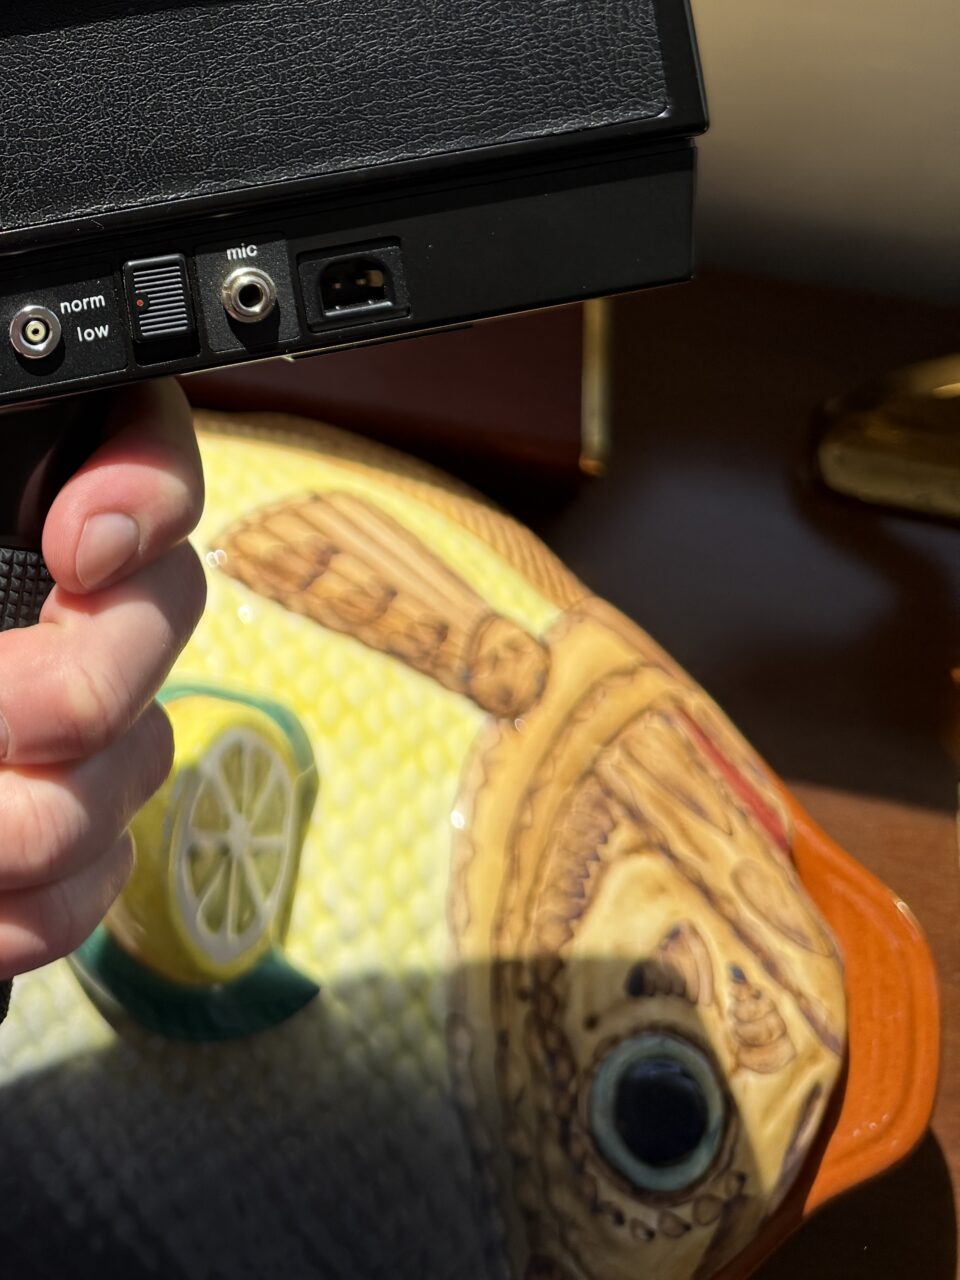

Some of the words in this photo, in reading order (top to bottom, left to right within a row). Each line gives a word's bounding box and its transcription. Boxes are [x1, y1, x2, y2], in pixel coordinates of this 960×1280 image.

[226, 243, 258, 261] mic
[58, 294, 106, 313] norm
[76, 324, 110, 342] low
